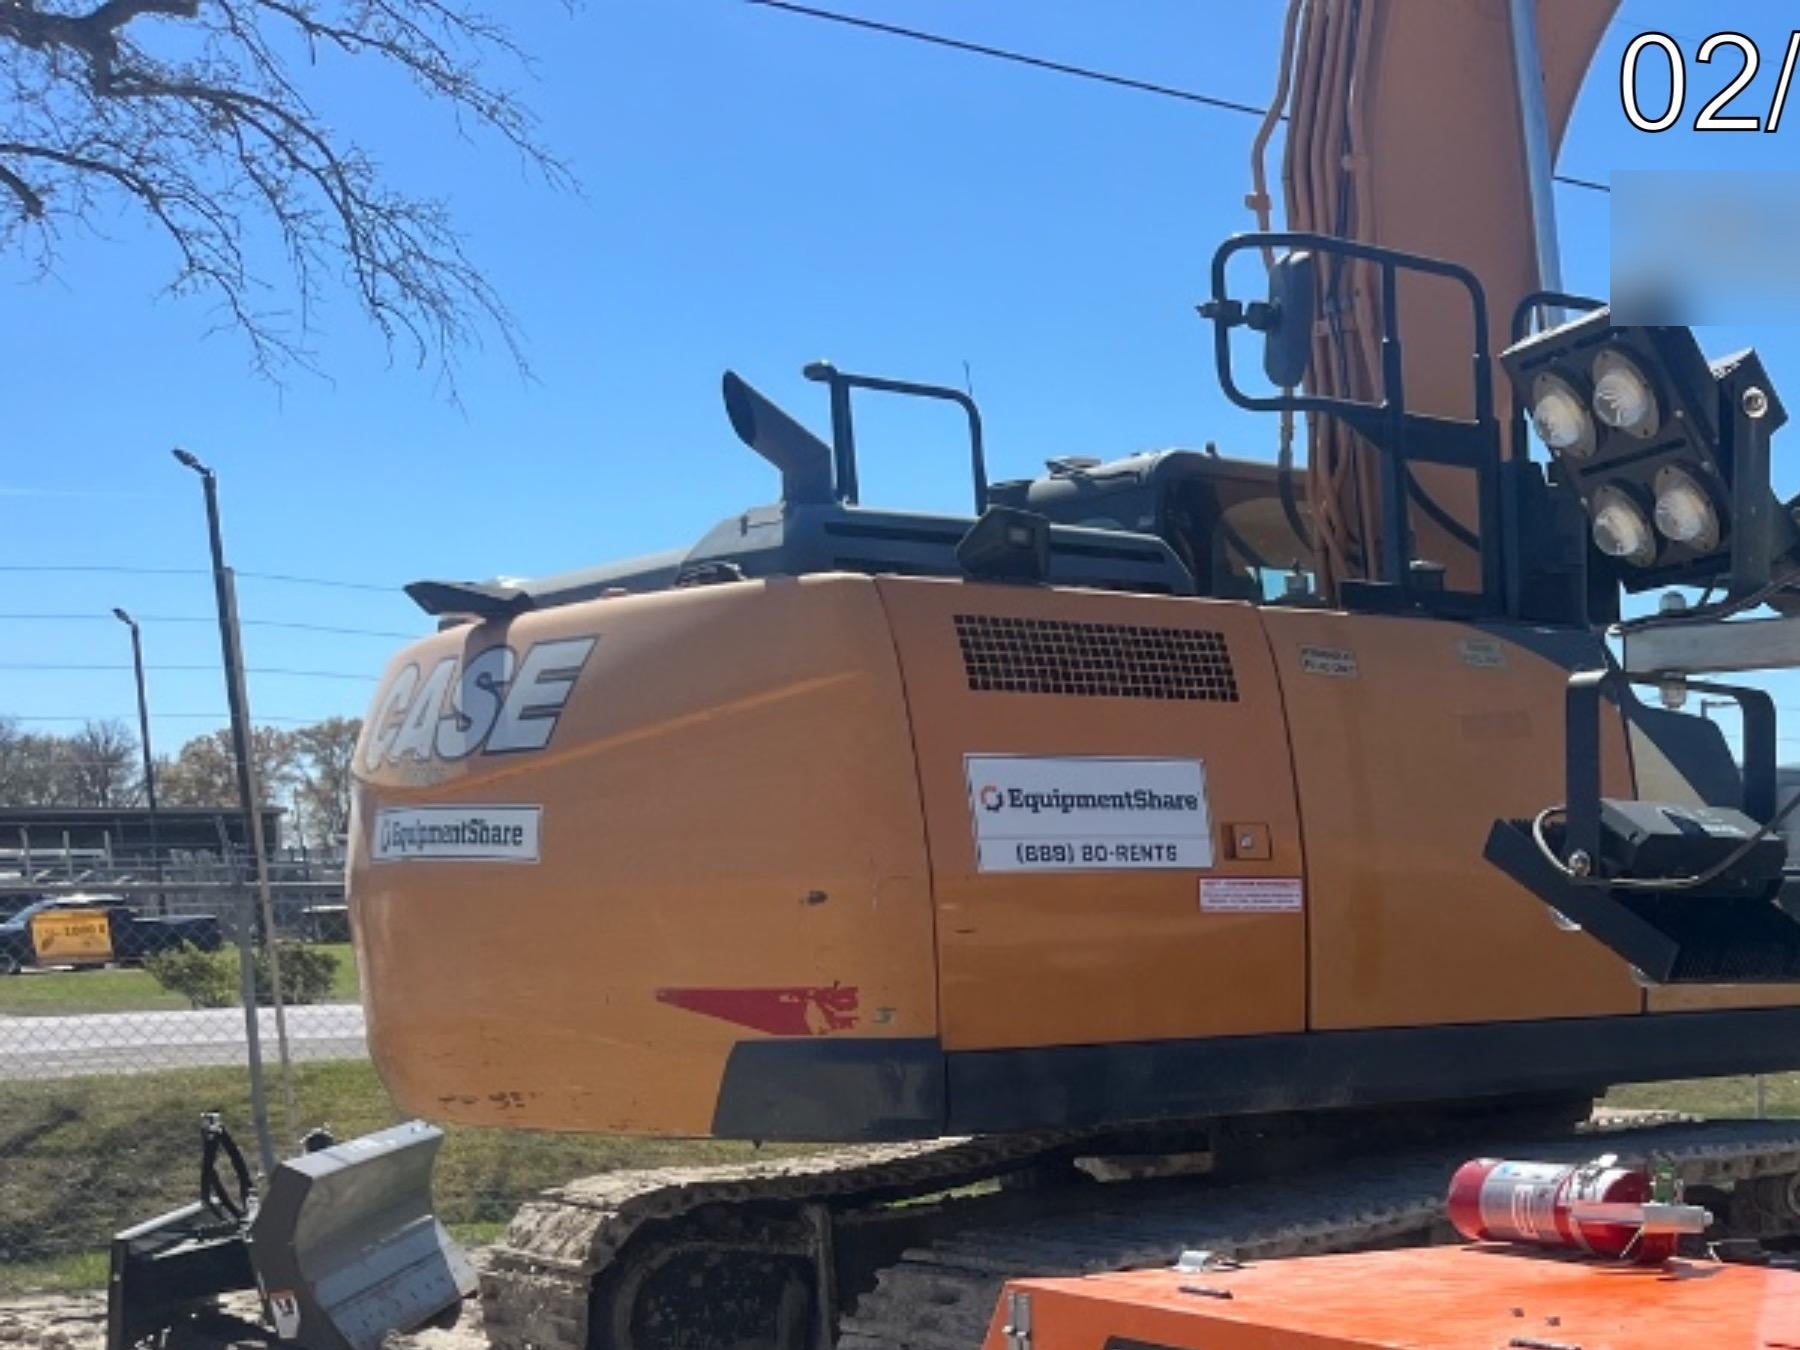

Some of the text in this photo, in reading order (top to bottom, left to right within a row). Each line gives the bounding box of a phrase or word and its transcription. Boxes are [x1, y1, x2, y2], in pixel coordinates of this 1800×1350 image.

[365, 634, 598, 773] CASE
[1007, 787, 1198, 814] EquipmentShare
[391, 818, 524, 852] EquipmentShare
[1016, 842, 1177, 864] (888) 80-RENTS
